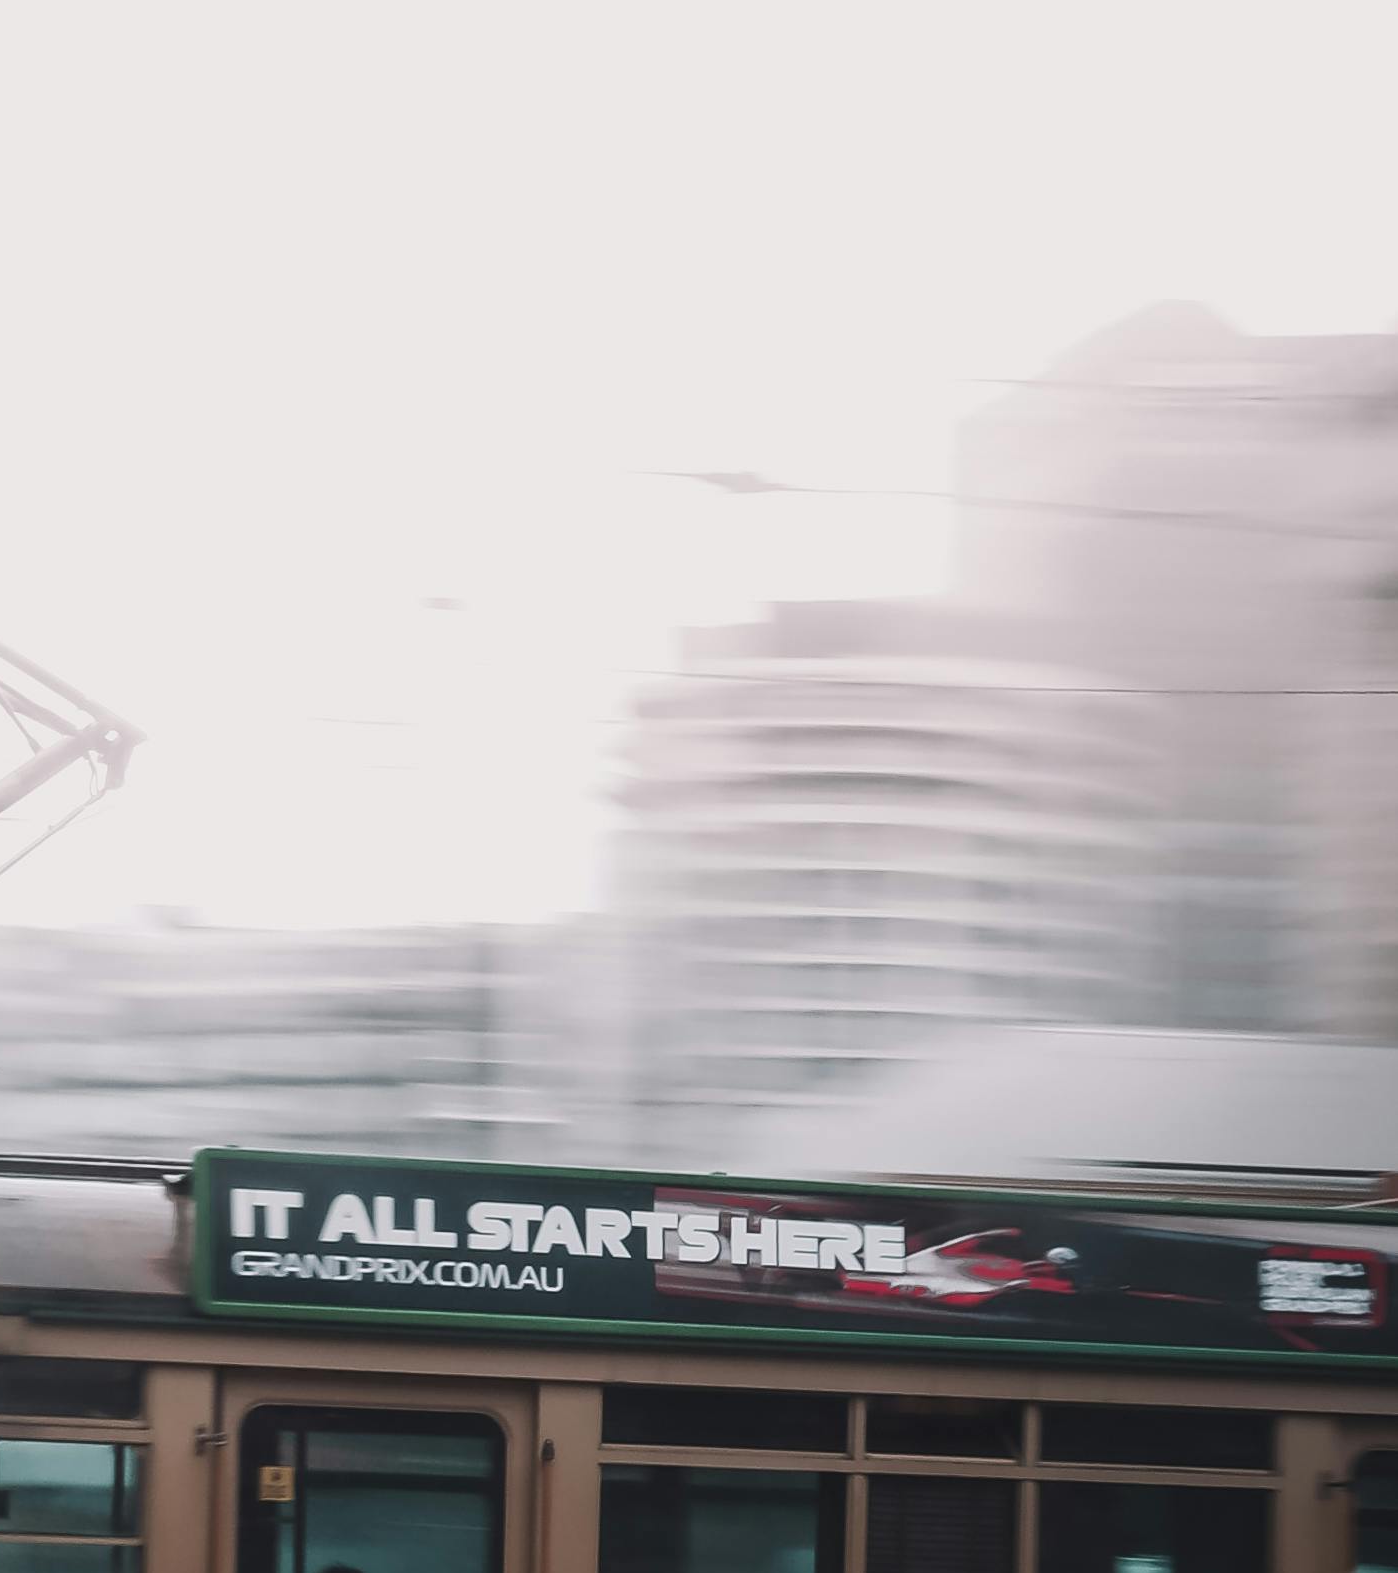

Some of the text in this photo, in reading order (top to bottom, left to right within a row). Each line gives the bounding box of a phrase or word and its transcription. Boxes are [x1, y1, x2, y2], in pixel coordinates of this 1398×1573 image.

[230, 1188, 905, 1273] IT ALL STARTS HERE
[231, 1250, 564, 1293] GRANDPRIX.COM.AU
